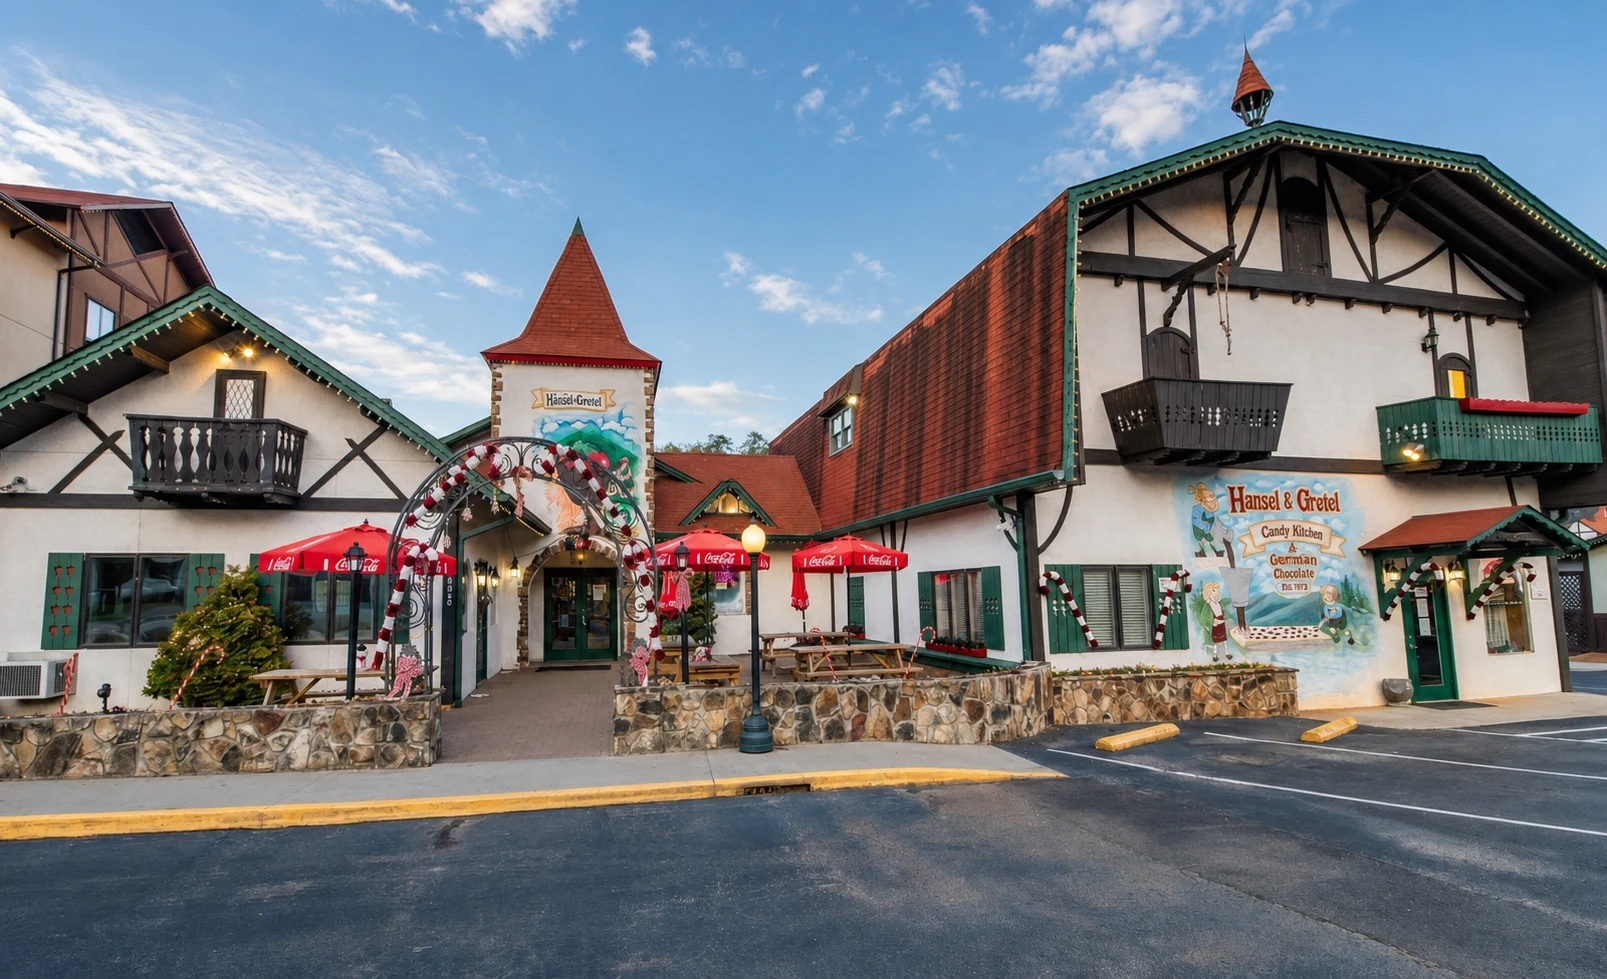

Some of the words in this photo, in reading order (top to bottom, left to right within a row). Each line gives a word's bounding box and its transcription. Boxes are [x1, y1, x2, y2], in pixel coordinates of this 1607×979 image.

[576, 395, 602, 407] Gretel
[1227, 485, 1281, 513] Hansel
[1283, 491, 1293, 510] &
[1296, 488, 1341, 512] Gretel
[1261, 525, 1290, 538] Candy
[1292, 524, 1323, 541] Kitchen
[1270, 553, 1318, 566] German
[1273, 568, 1315, 579] Chocolate
